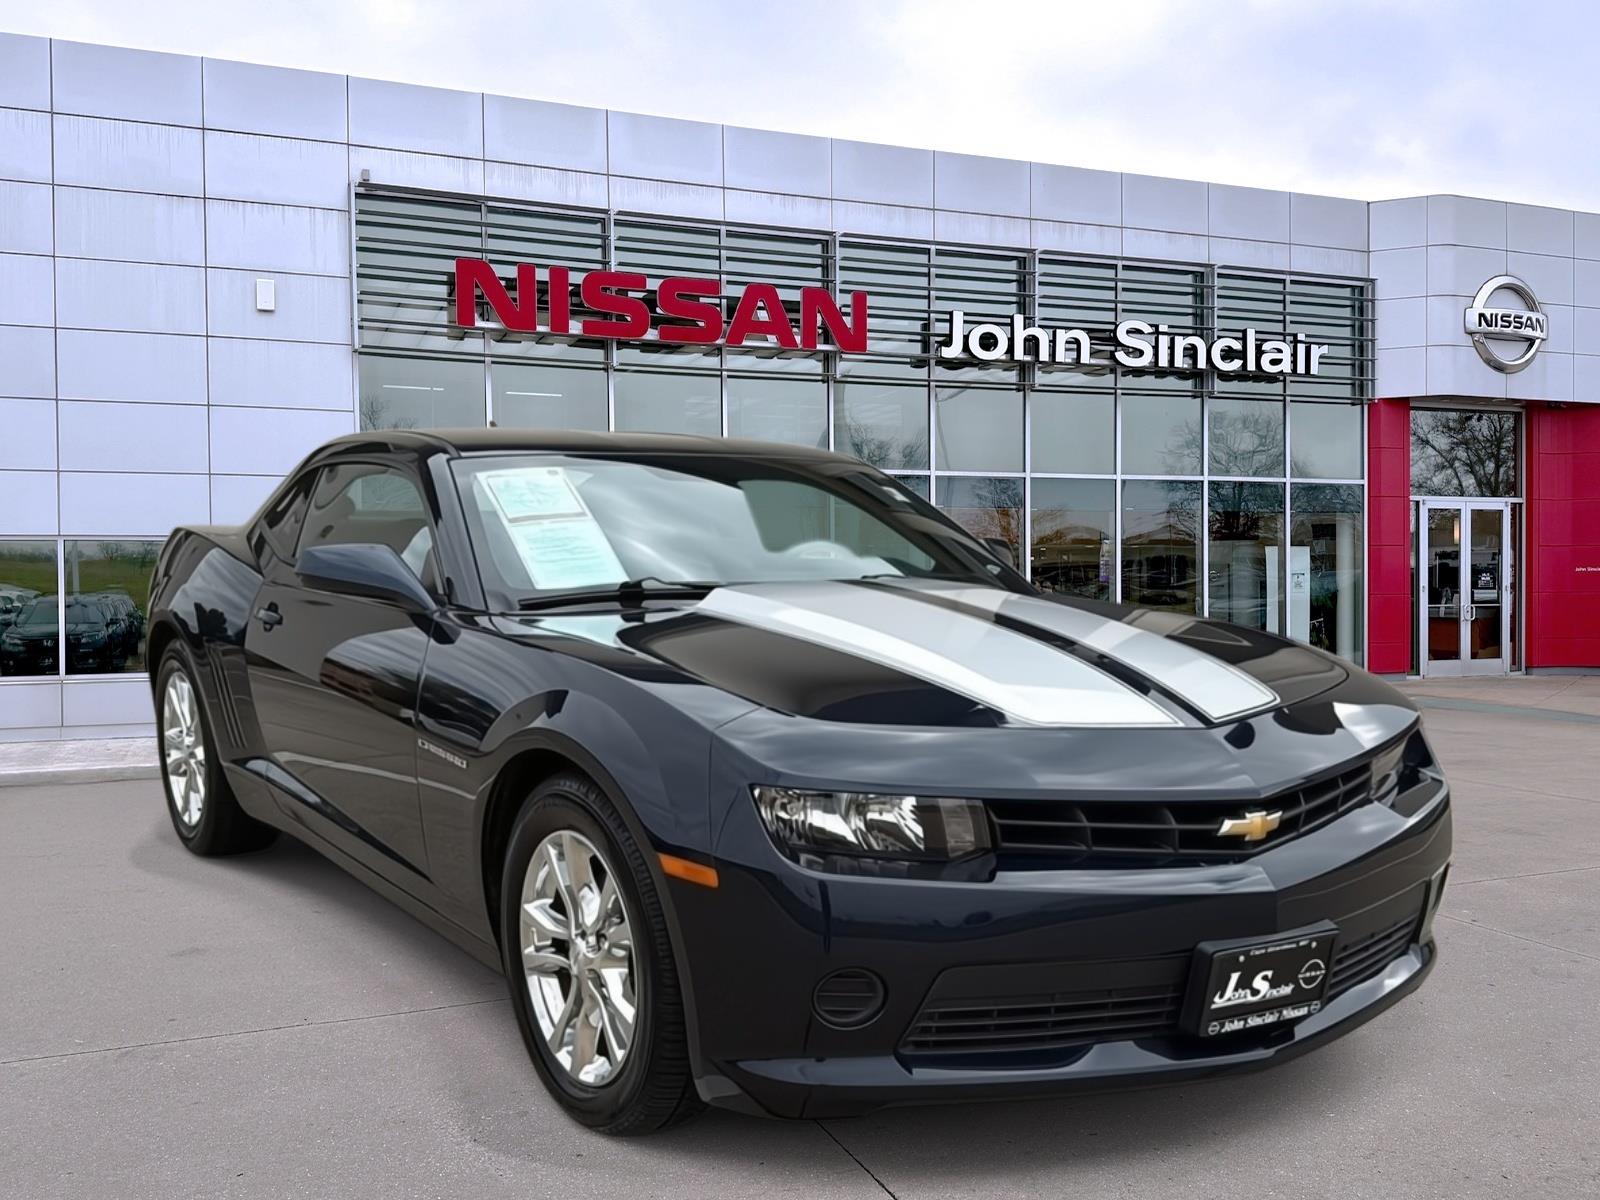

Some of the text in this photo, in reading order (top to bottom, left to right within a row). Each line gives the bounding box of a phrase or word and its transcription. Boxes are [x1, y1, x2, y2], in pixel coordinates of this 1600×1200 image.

[455, 257, 868, 353] NISSAN
[1477, 312, 1545, 334] NISSAN
[940, 310, 1329, 375] John Sinclair
[1221, 1018, 1245, 1033] John
